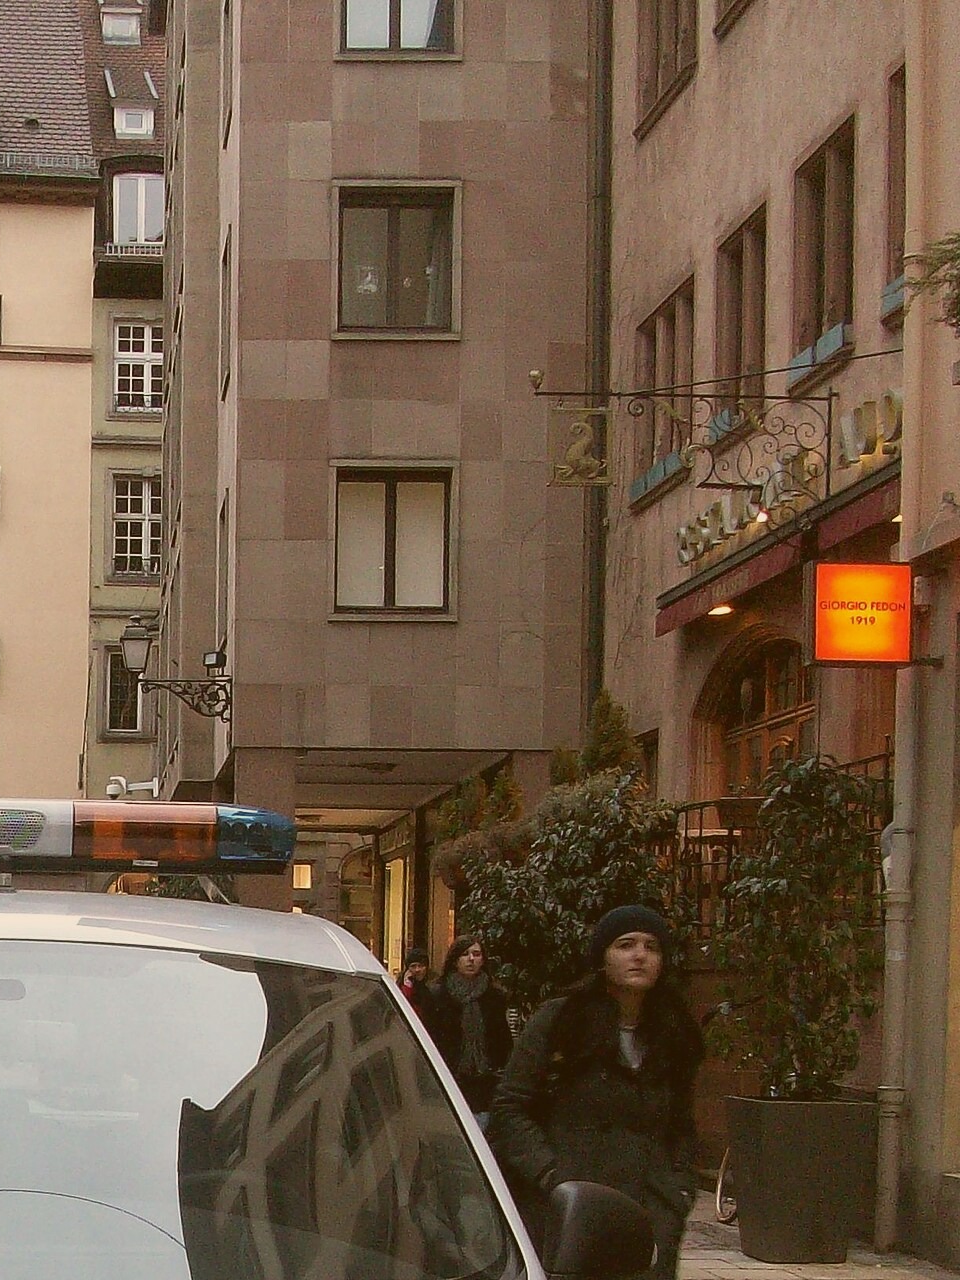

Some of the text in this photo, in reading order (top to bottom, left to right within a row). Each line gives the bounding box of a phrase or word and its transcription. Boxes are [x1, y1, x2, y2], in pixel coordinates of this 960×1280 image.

[820, 600, 906, 612] GIORGIO FEDON
[850, 616, 876, 625] 1919
